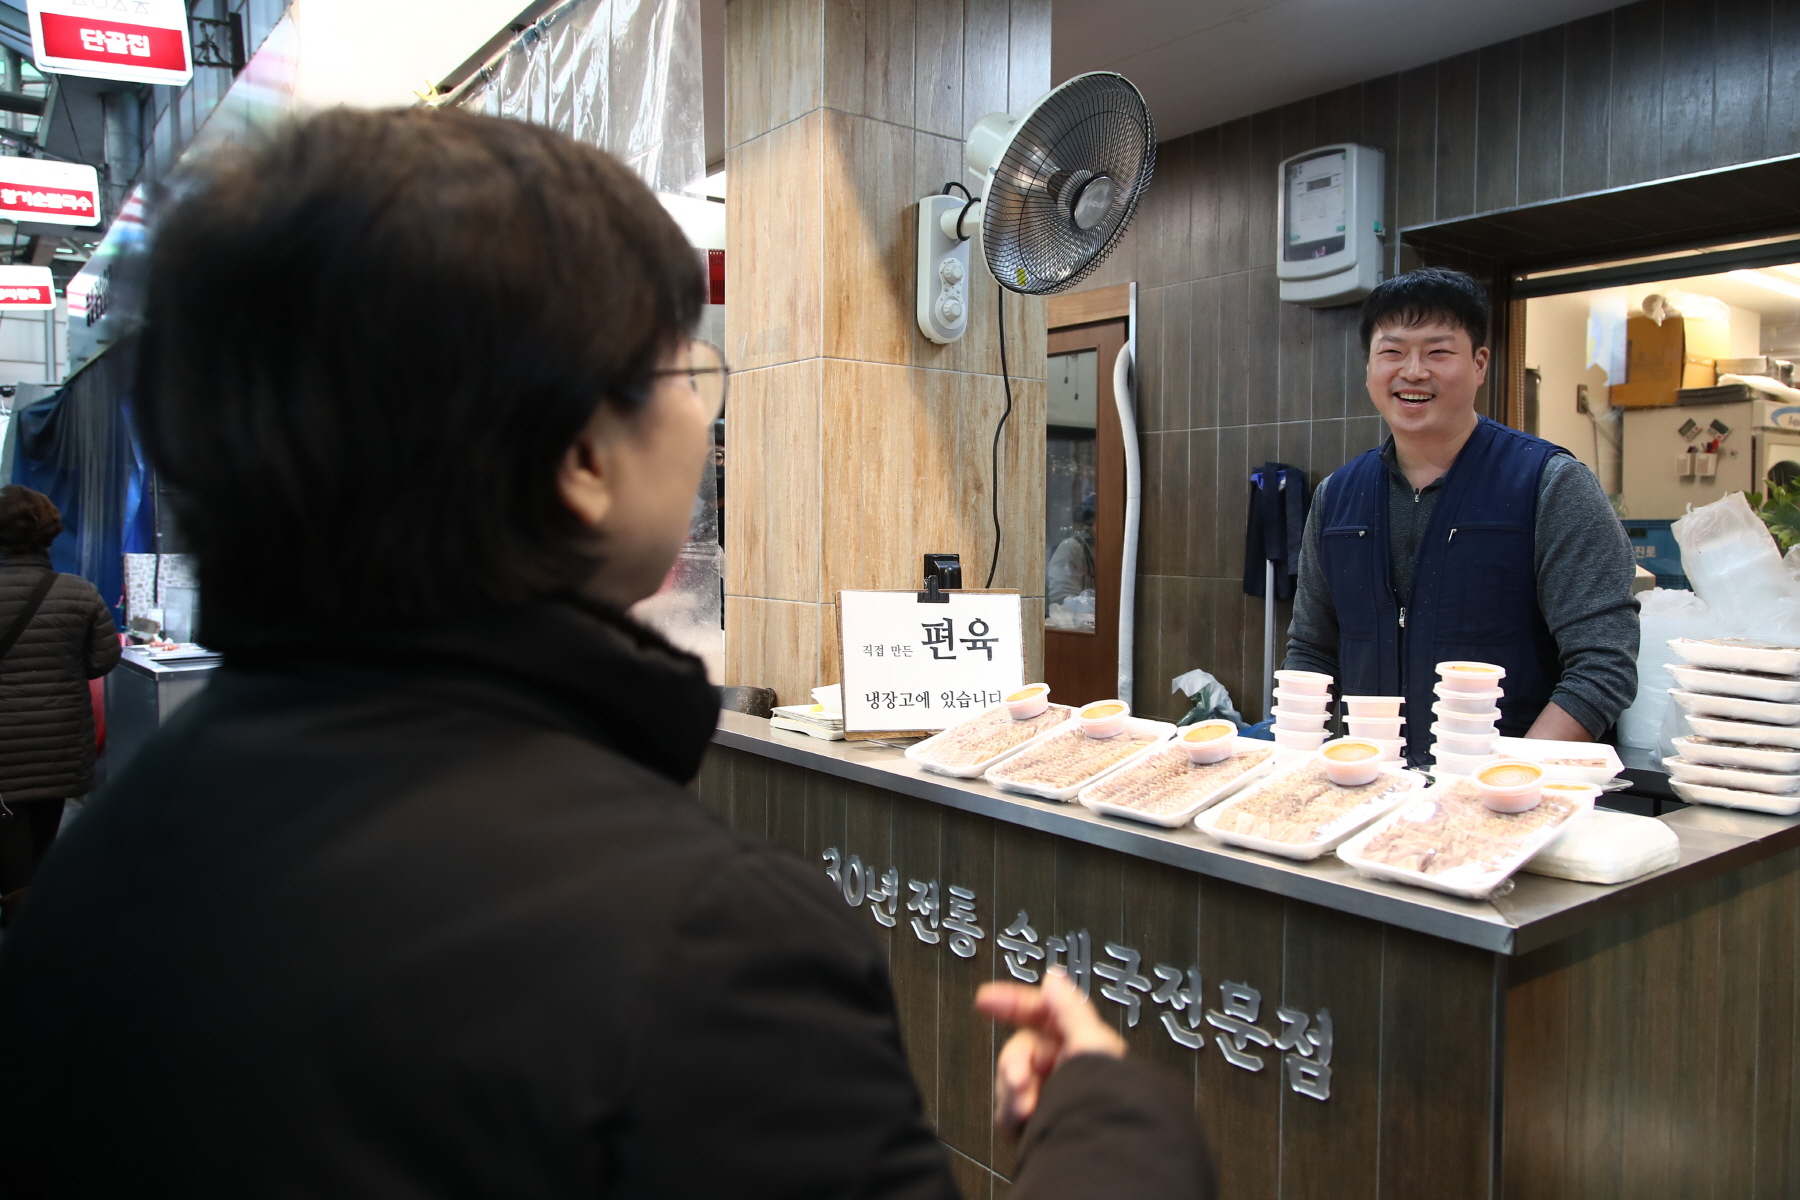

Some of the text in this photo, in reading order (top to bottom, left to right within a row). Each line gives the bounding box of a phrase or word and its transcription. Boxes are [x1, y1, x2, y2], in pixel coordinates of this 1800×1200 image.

[80, 28, 151, 57] 단골집
[862, 617, 999, 662] 직접 만든 편육
[865, 689, 1002, 709] 냉장고에 있습니다
[821, 846, 1334, 1101] 30년 전통 순대국전문점
